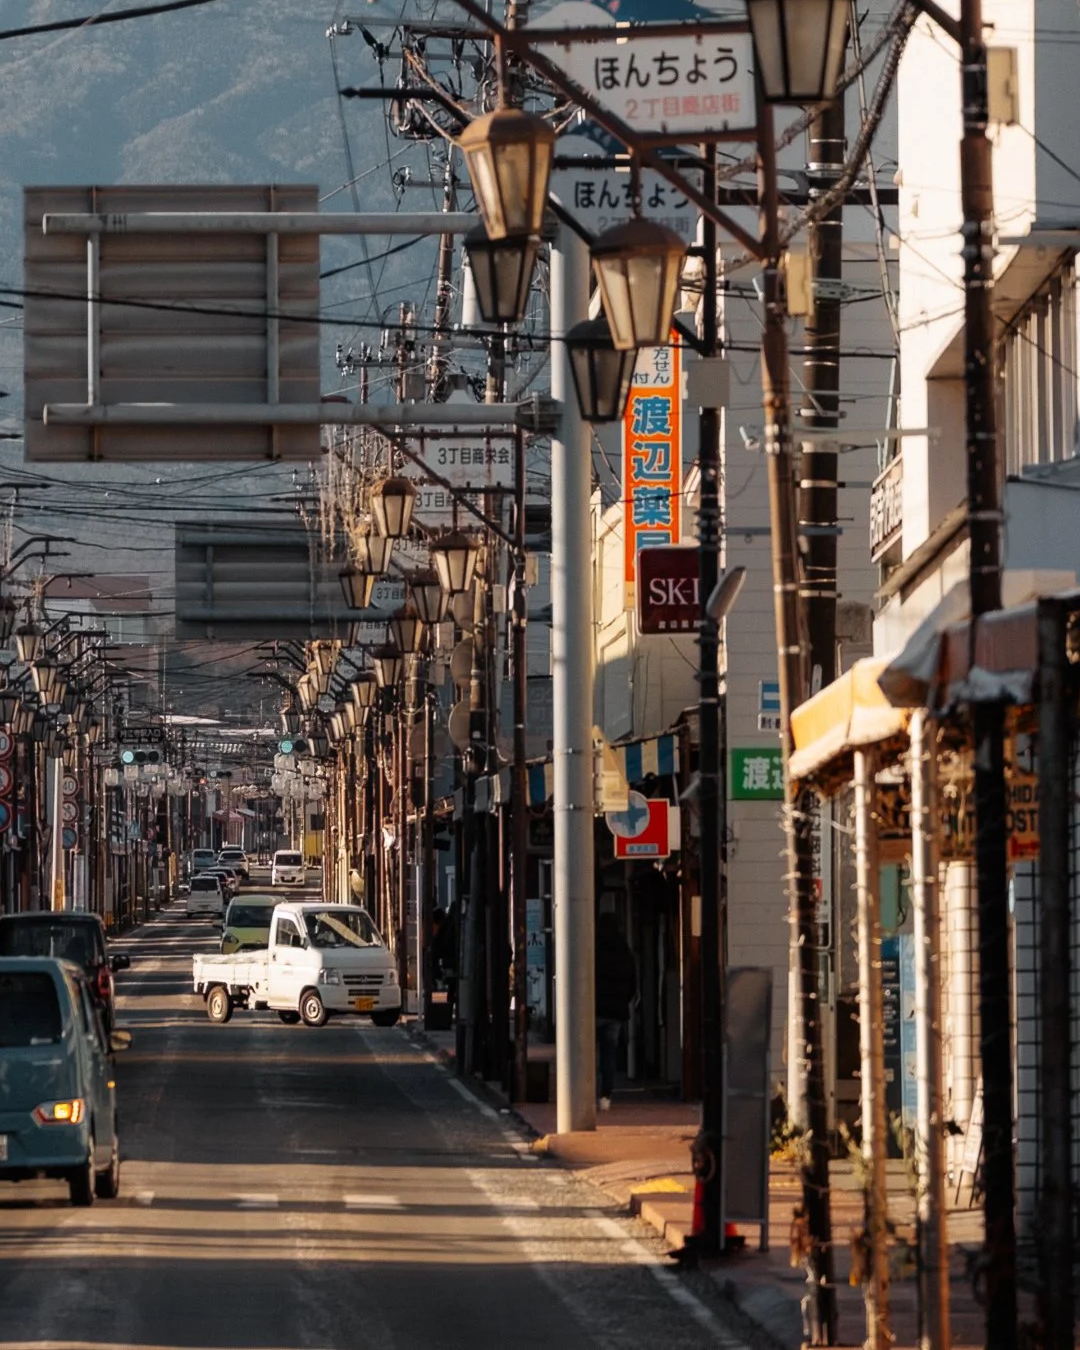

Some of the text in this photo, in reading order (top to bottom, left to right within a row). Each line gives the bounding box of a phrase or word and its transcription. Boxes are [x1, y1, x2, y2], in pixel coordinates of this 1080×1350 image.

[594, 47, 738, 91] ほんちょう
[438, 447, 510, 465] 3丁目商栄会
